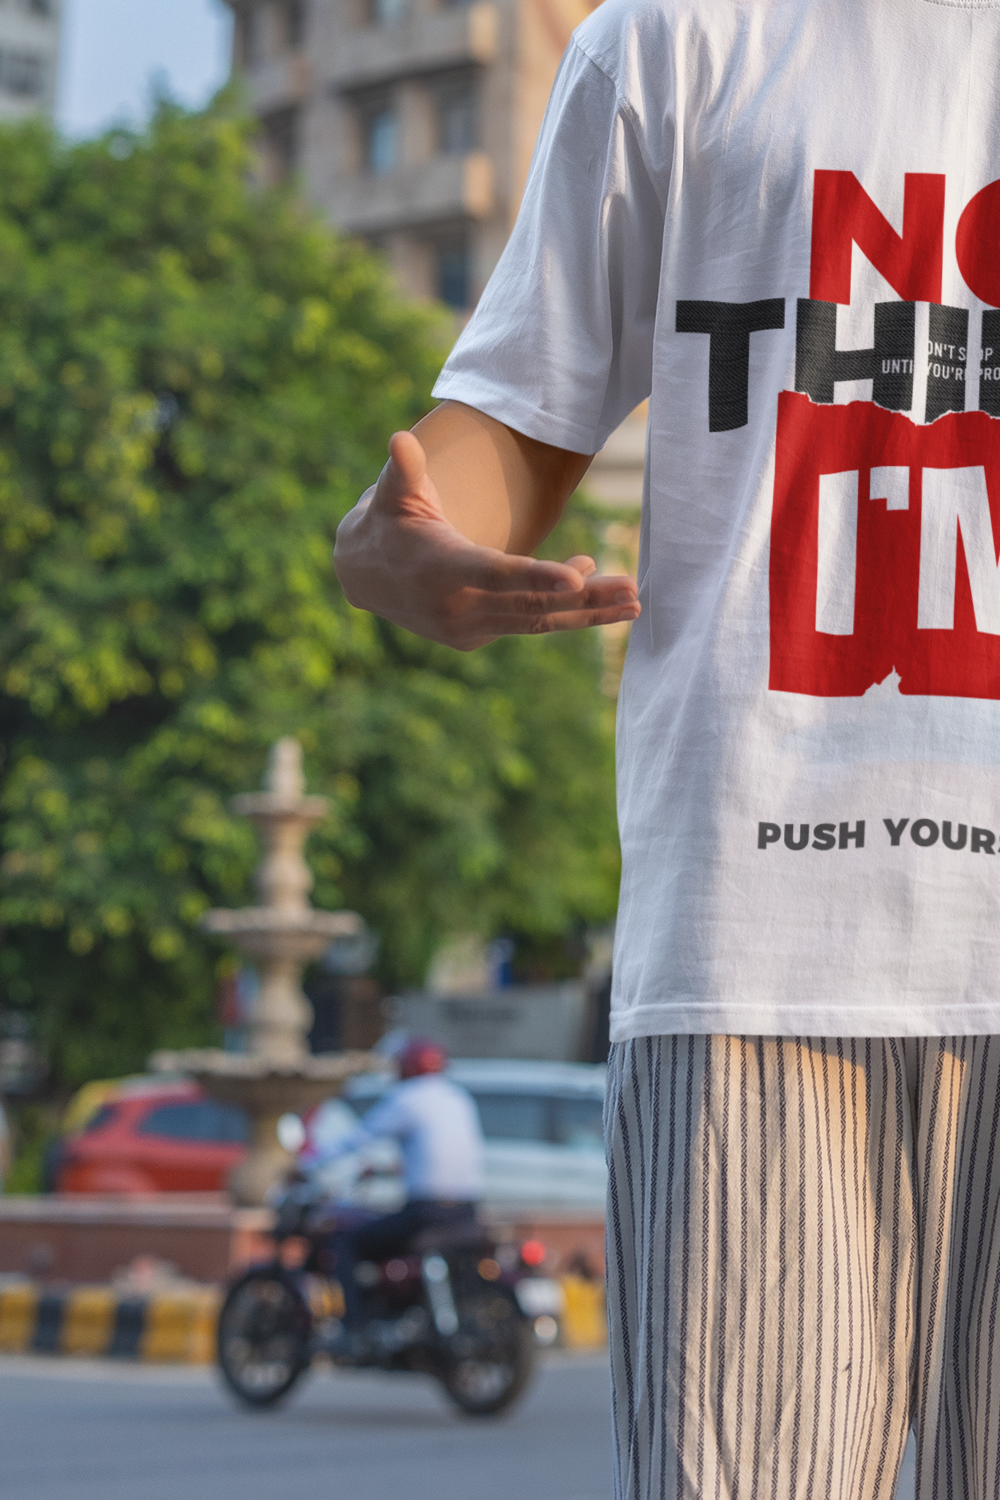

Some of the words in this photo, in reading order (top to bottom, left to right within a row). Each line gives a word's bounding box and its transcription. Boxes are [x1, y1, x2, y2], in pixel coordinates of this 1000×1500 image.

[928, 340, 956, 360] ON'T
[958, 347, 994, 362] SP
[881, 359, 914, 374] UNTI
[757, 820, 866, 851] PUSH
